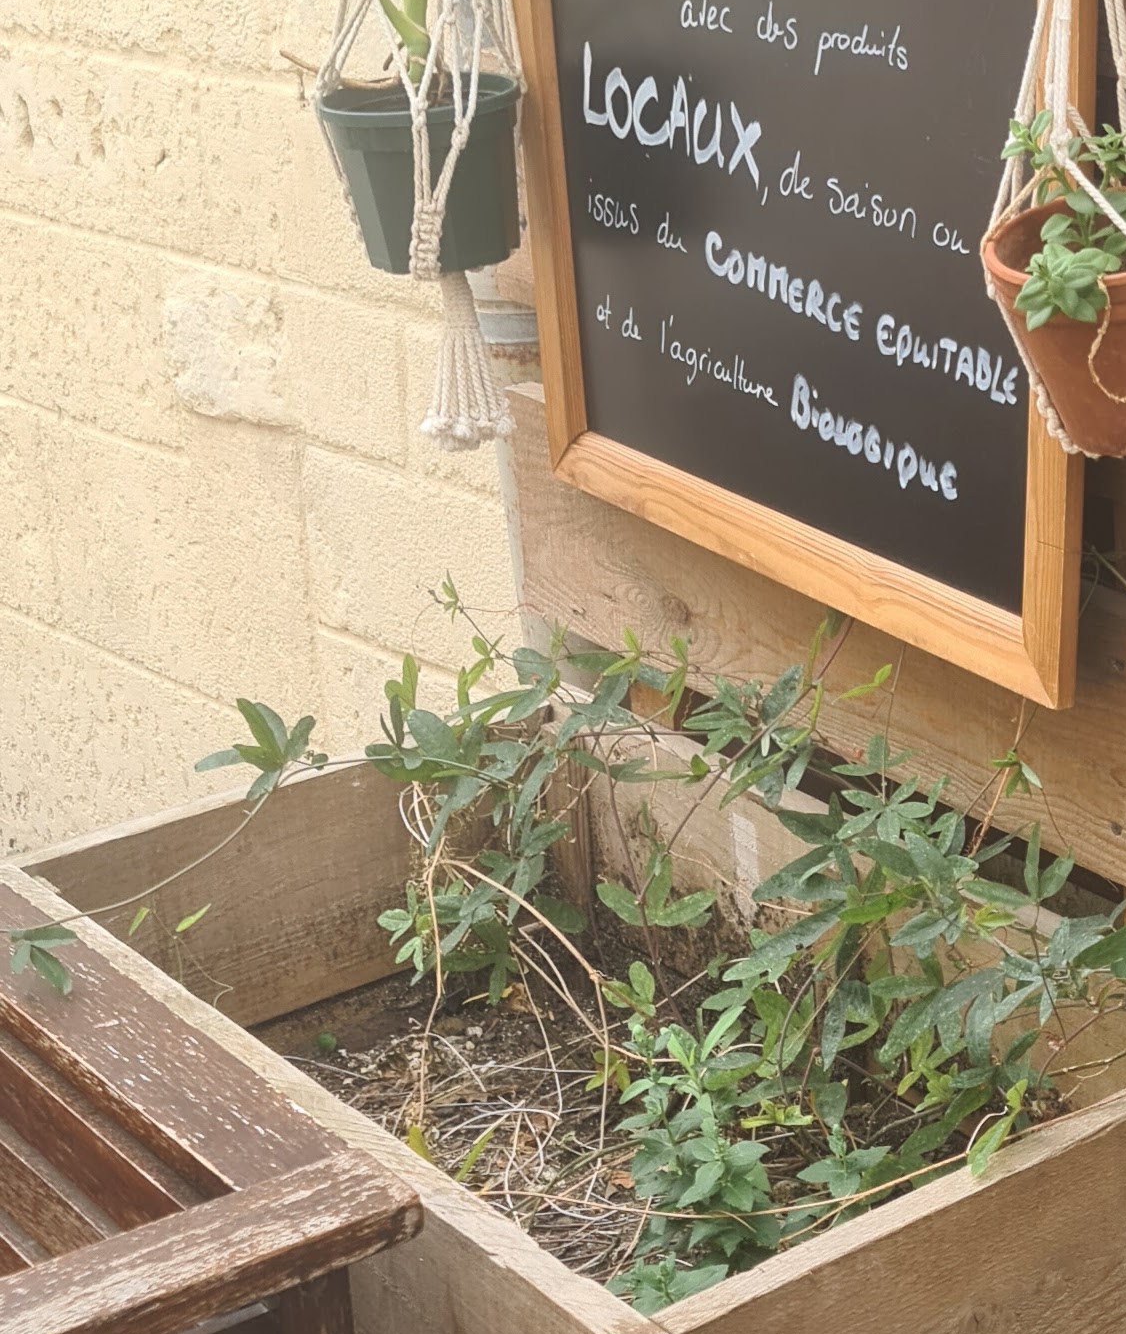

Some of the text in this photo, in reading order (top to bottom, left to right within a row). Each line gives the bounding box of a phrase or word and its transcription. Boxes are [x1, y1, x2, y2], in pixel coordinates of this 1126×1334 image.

[756, 0, 799, 51] des
[813, 24, 909, 76] produits
[779, 150, 814, 200] de
[932, 222, 970, 255] ou
[587, 177, 640, 235] issus
[656, 211, 688, 253] du
[705, 230, 864, 342] COMMERCE
[596, 294, 612, 330] et
[621, 306, 643, 341] de
[660, 314, 779, 407] l'agriculture
